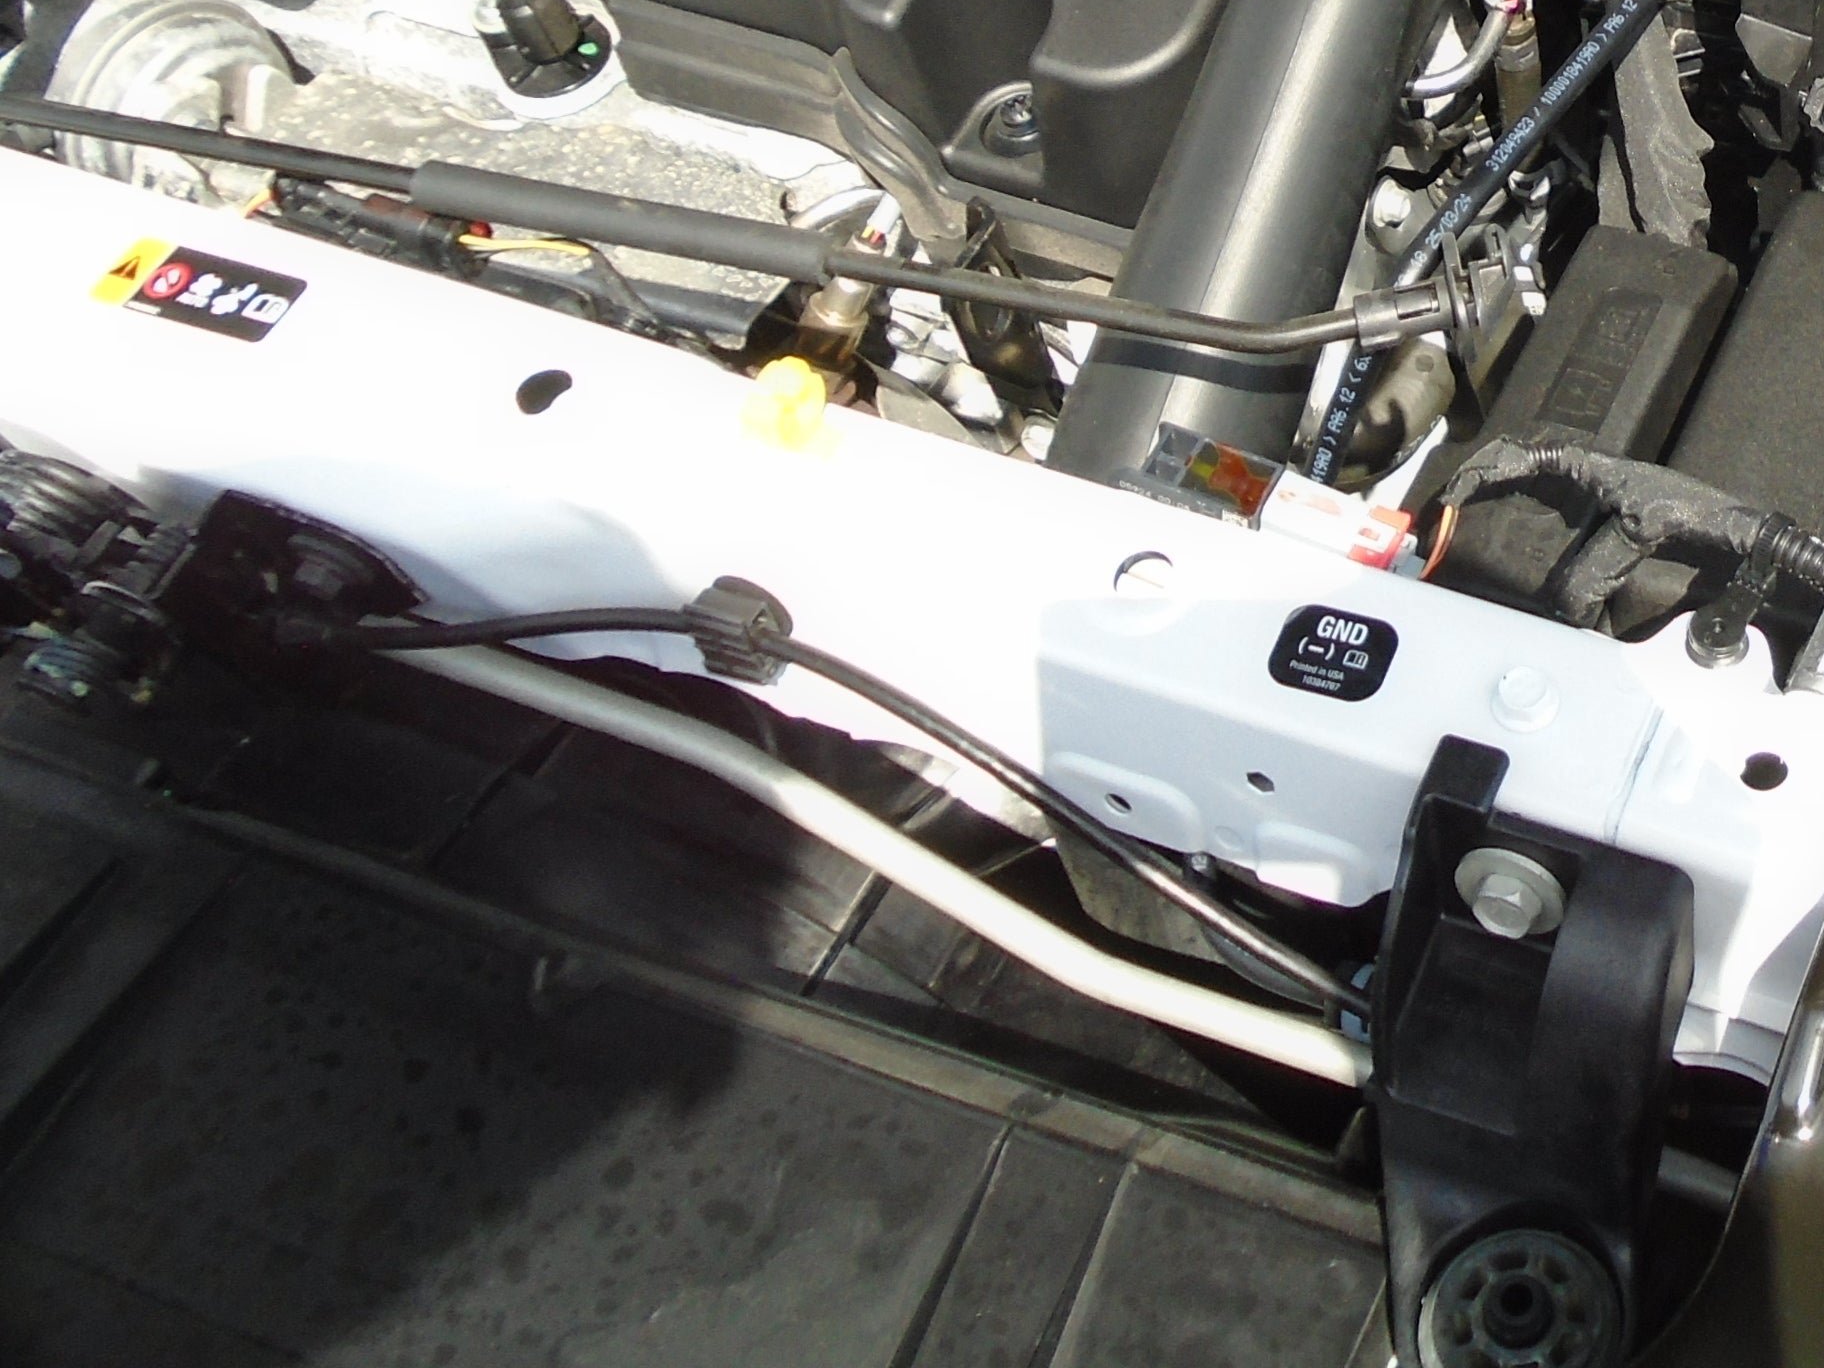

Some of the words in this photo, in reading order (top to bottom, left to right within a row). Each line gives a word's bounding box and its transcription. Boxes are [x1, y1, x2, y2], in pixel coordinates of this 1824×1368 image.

[1486, 116, 1535, 172] 312049423
[1317, 616, 1368, 645] GND
[1289, 659, 1318, 674] Printed
[1327, 669, 1344, 681] USA
